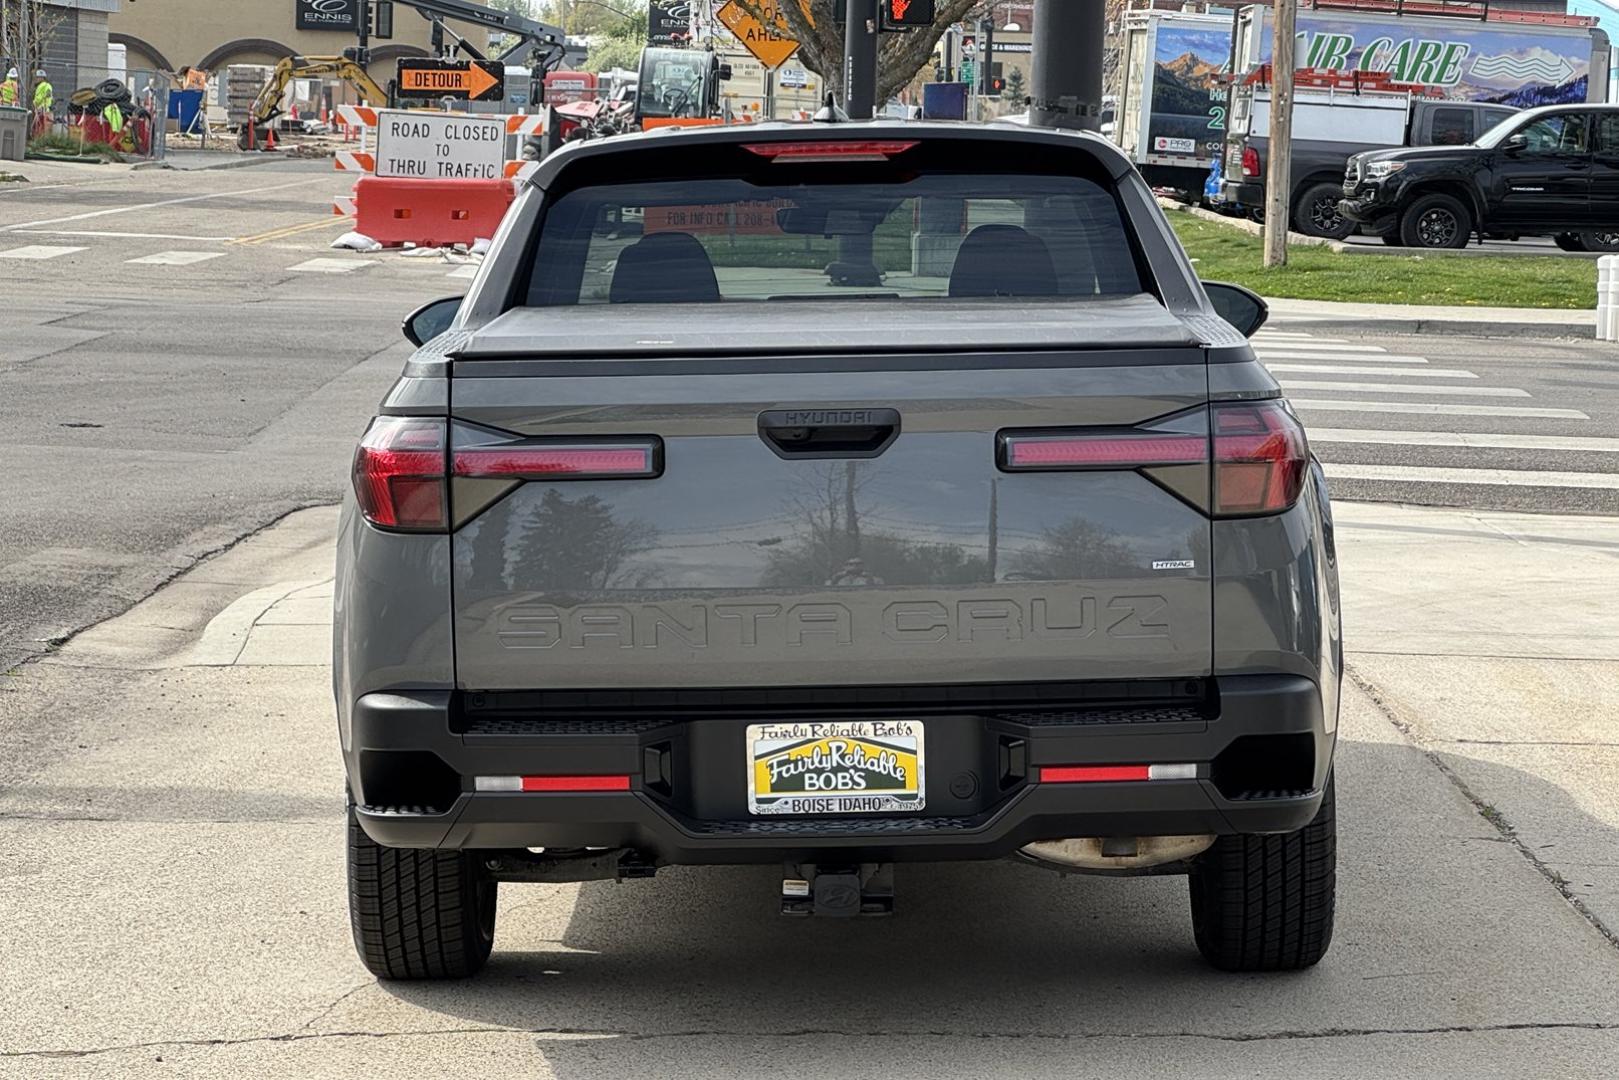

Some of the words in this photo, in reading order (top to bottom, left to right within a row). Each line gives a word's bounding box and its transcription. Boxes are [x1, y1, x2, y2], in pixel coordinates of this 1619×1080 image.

[304, 12, 353, 21] ENNIS
[1358, 36, 1472, 87] CARE
[414, 72, 463, 88] DETOUR
[391, 122, 431, 138] ROAD
[444, 125, 499, 142] CLOSED
[435, 143, 450, 157] TO
[388, 158, 427, 176] THRU
[437, 161, 496, 180] TRAFFIC
[667, 211, 686, 226] FOR
[690, 210, 713, 226] INFO
[785, 411, 873, 425] HYUNDAI
[1154, 560, 1194, 569] HTRAC
[497, 602, 853, 649] SANTA
[882, 594, 1169, 643] CRUZ
[758, 723, 808, 740] Fairly
[809, 723, 870, 738] Reliable
[871, 720, 913, 736] Bob's
[767, 746, 832, 784] Fairly
[828, 741, 906, 780] Reliable
[804, 768, 867, 791] BOB'S
[792, 799, 835, 813] BOISE
[838, 798, 881, 812] IDAHO
